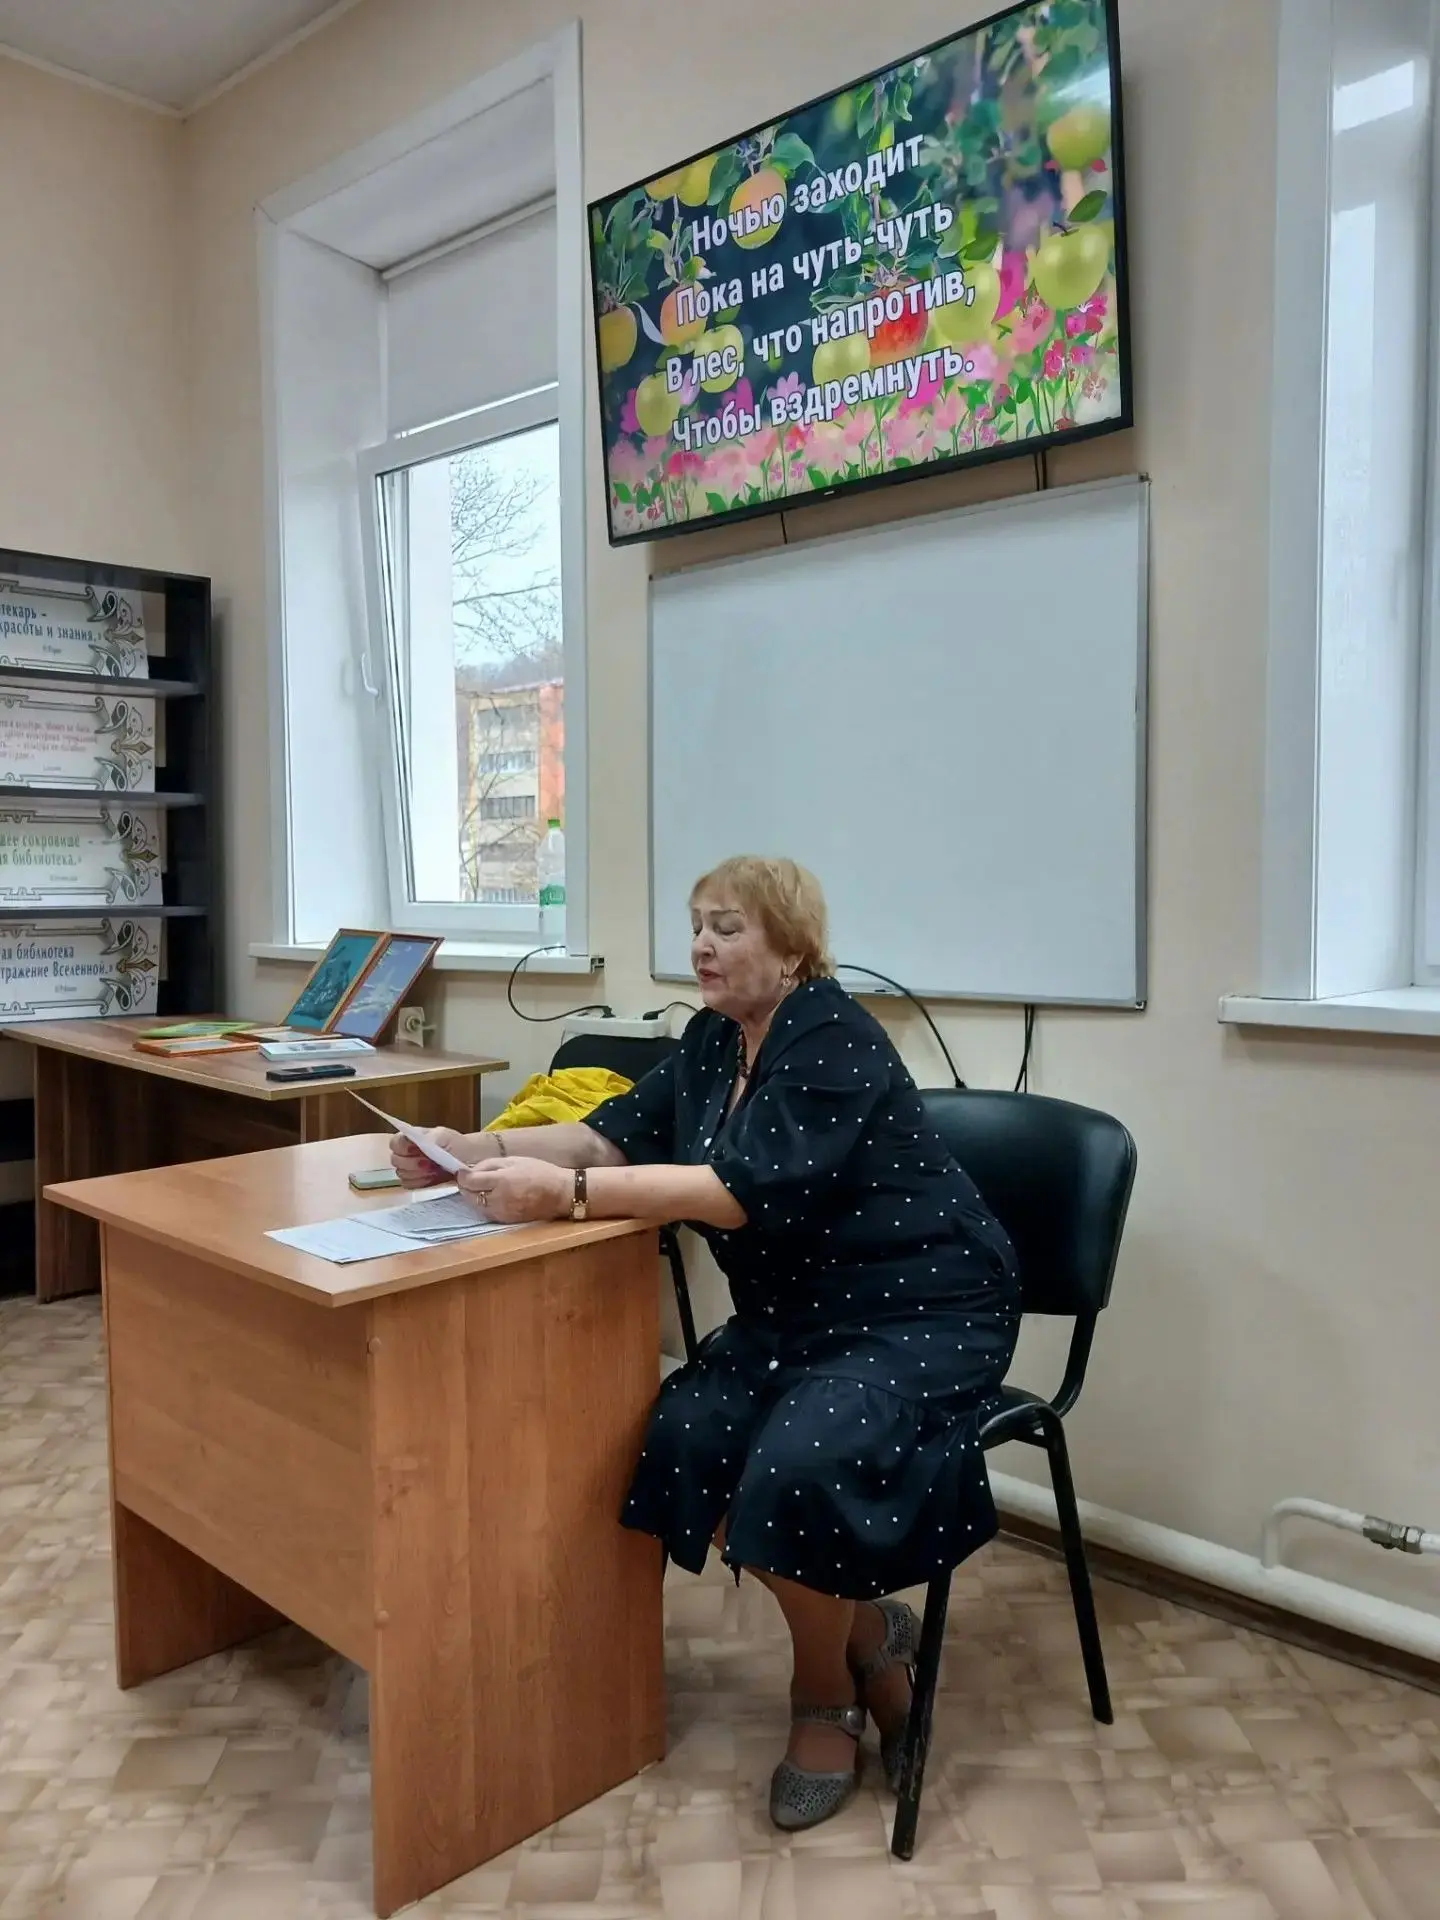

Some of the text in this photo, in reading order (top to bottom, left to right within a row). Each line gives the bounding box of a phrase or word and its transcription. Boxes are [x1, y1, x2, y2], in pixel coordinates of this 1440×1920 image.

[691, 134, 925, 255] Ночью заходит
[675, 201, 954, 327] Пока на чуть-чуть
[666, 270, 976, 393] В лес, что напротив,
[672, 347, 975, 452] Чтобы вздремнуть.
[47, 626, 53, 638] и
[17, 942, 74, 960] библиотека
